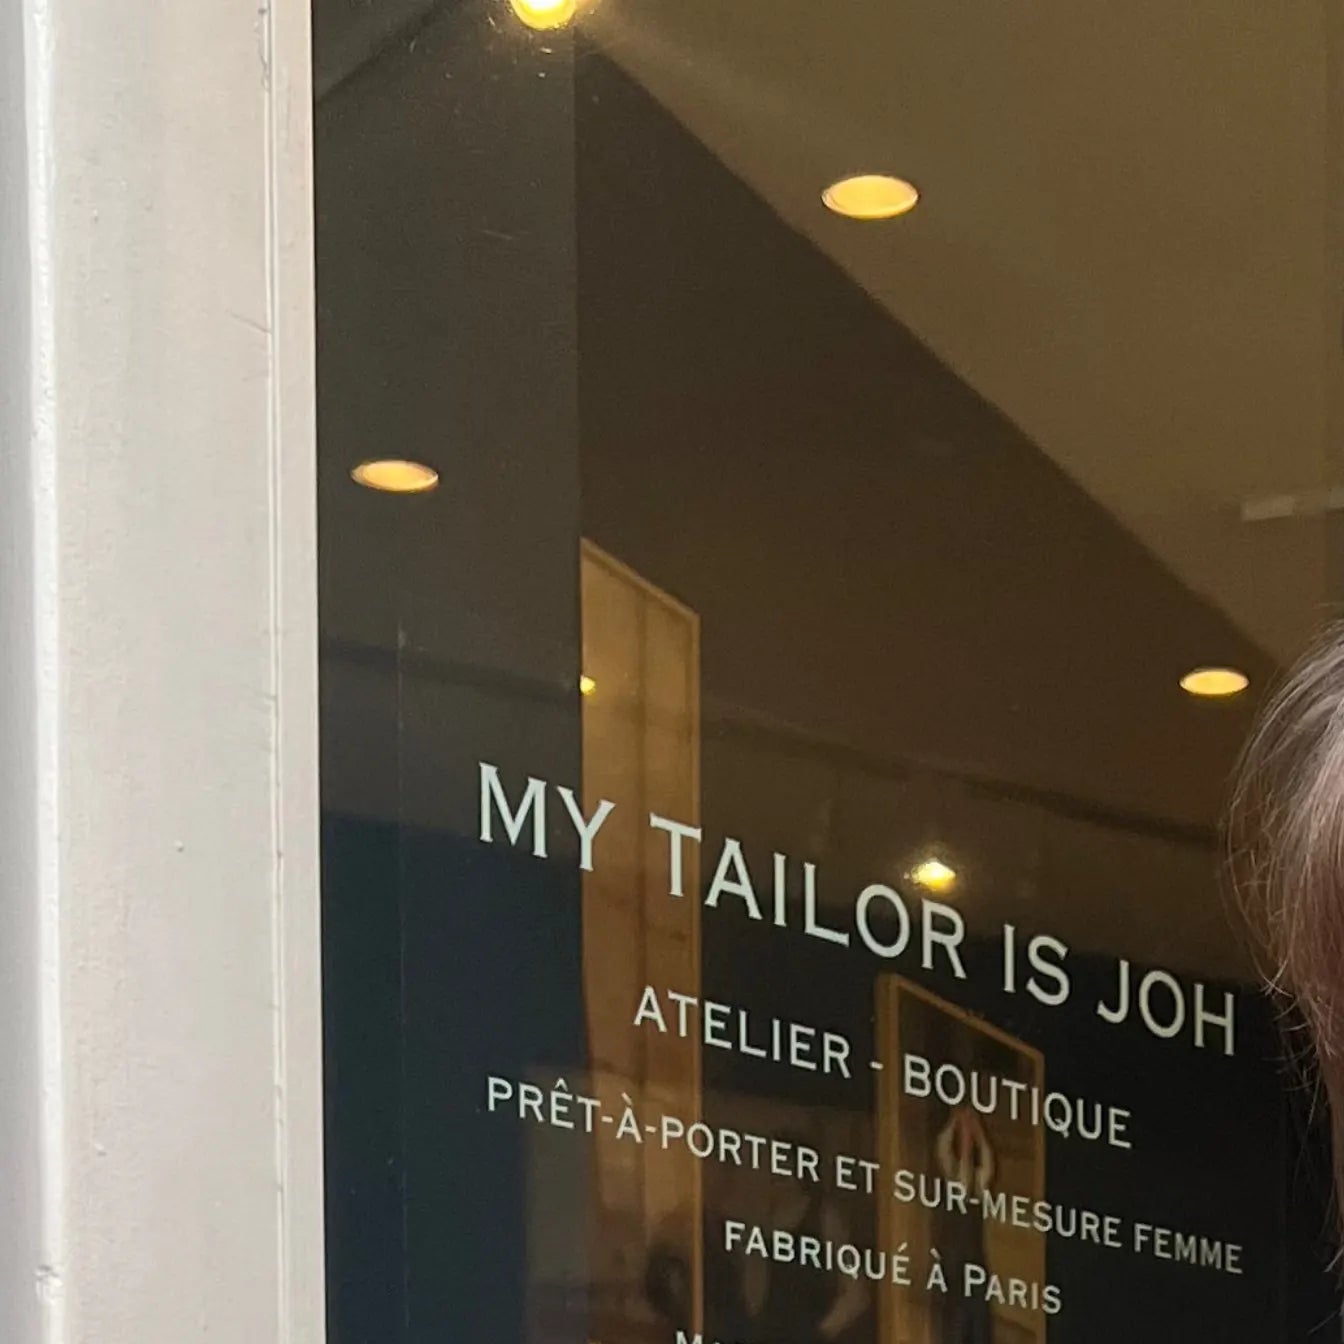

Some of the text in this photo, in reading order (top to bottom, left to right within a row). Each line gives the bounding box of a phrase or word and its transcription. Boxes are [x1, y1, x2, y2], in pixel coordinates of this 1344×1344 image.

[478, 762, 1236, 1056] MY TAILOR IS JOH
[634, 986, 852, 1080] ATELIER
[903, 1055, 1132, 1149] BOUTIQUE
[486, 1077, 1244, 1275] PRÊT-À-PORTER ET SUR-MESURE FEMME
[724, 1220, 1063, 1315] FABRIQUÉ À PARIS
